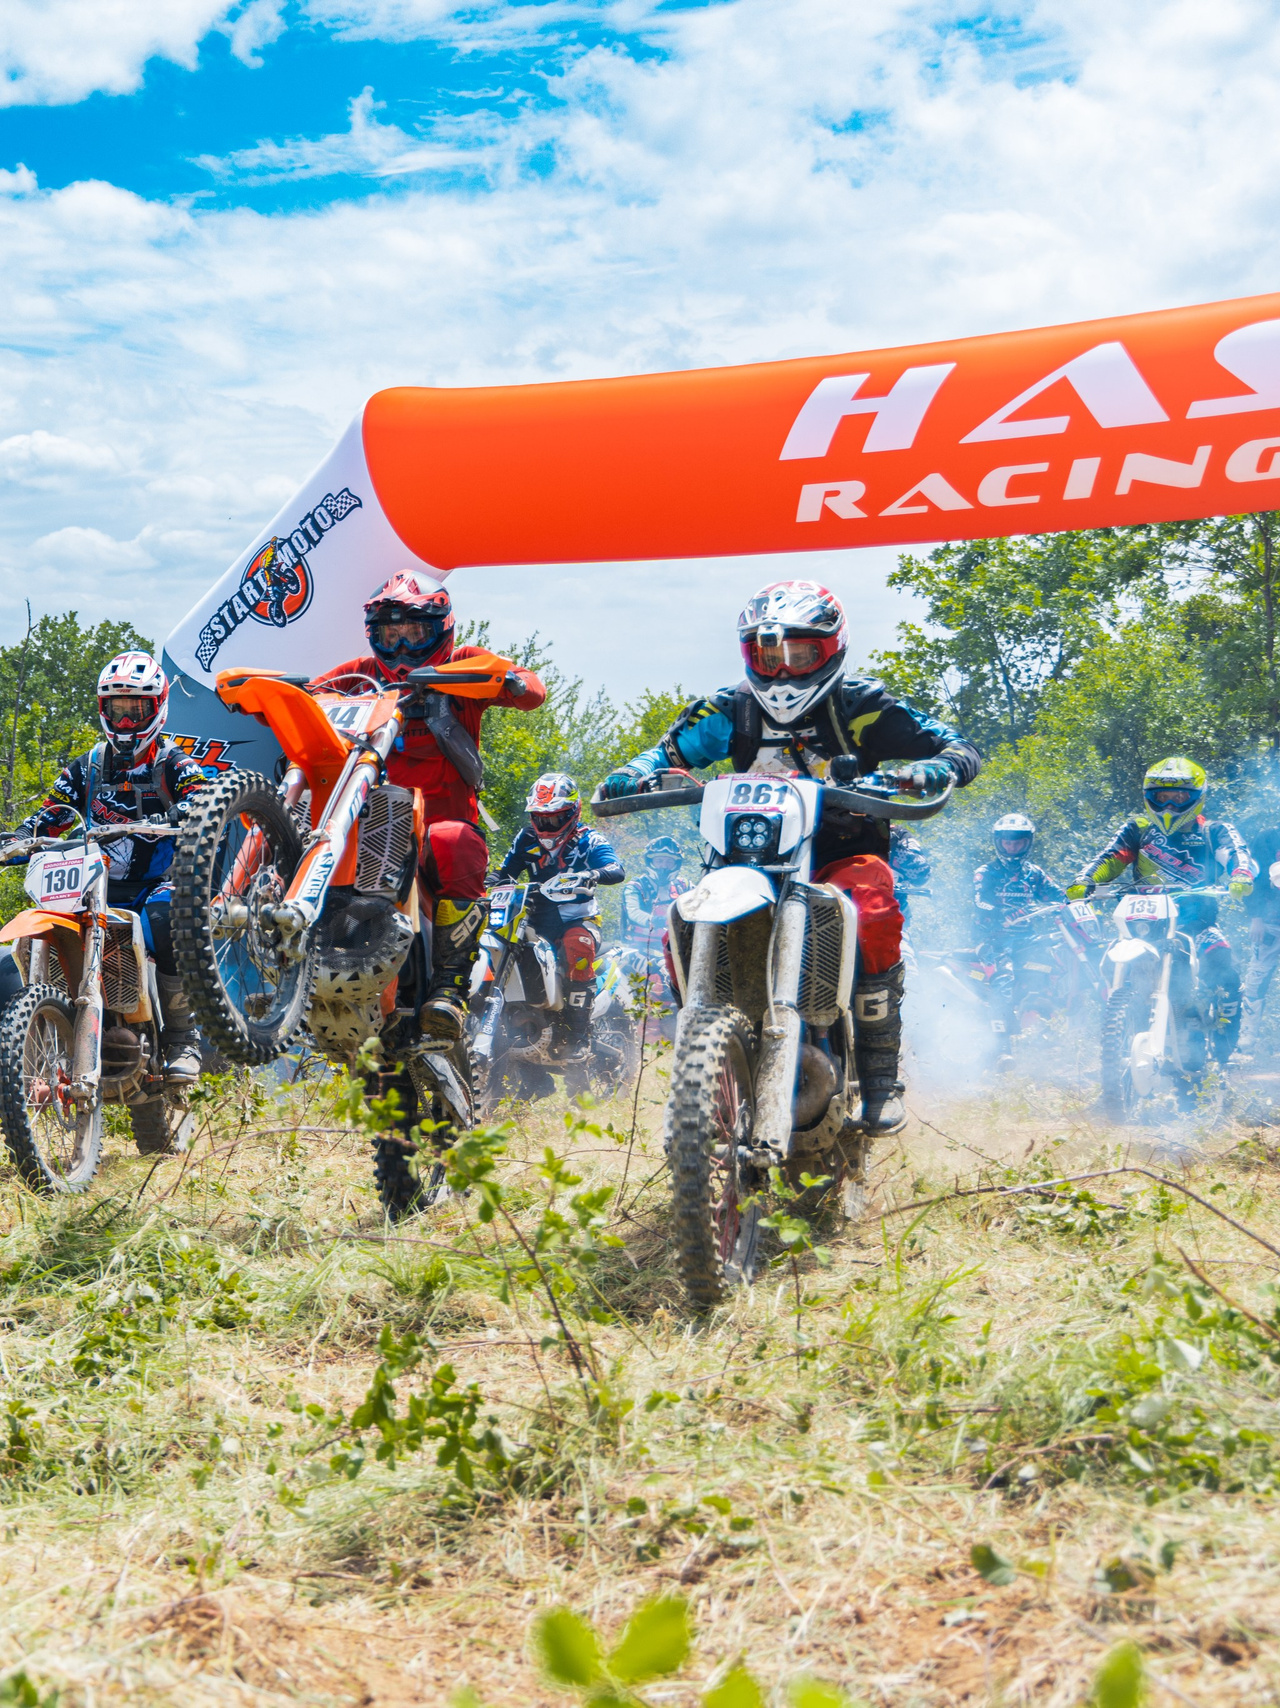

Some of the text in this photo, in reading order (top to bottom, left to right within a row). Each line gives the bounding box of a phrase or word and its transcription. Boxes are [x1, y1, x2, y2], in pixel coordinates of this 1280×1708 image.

[795, 436, 1280, 522] RACING
[276, 504, 334, 573] MOTO
[731, 783, 789, 805] 861
[44, 867, 80, 893] 130
[1129, 900, 1158, 915] 135
